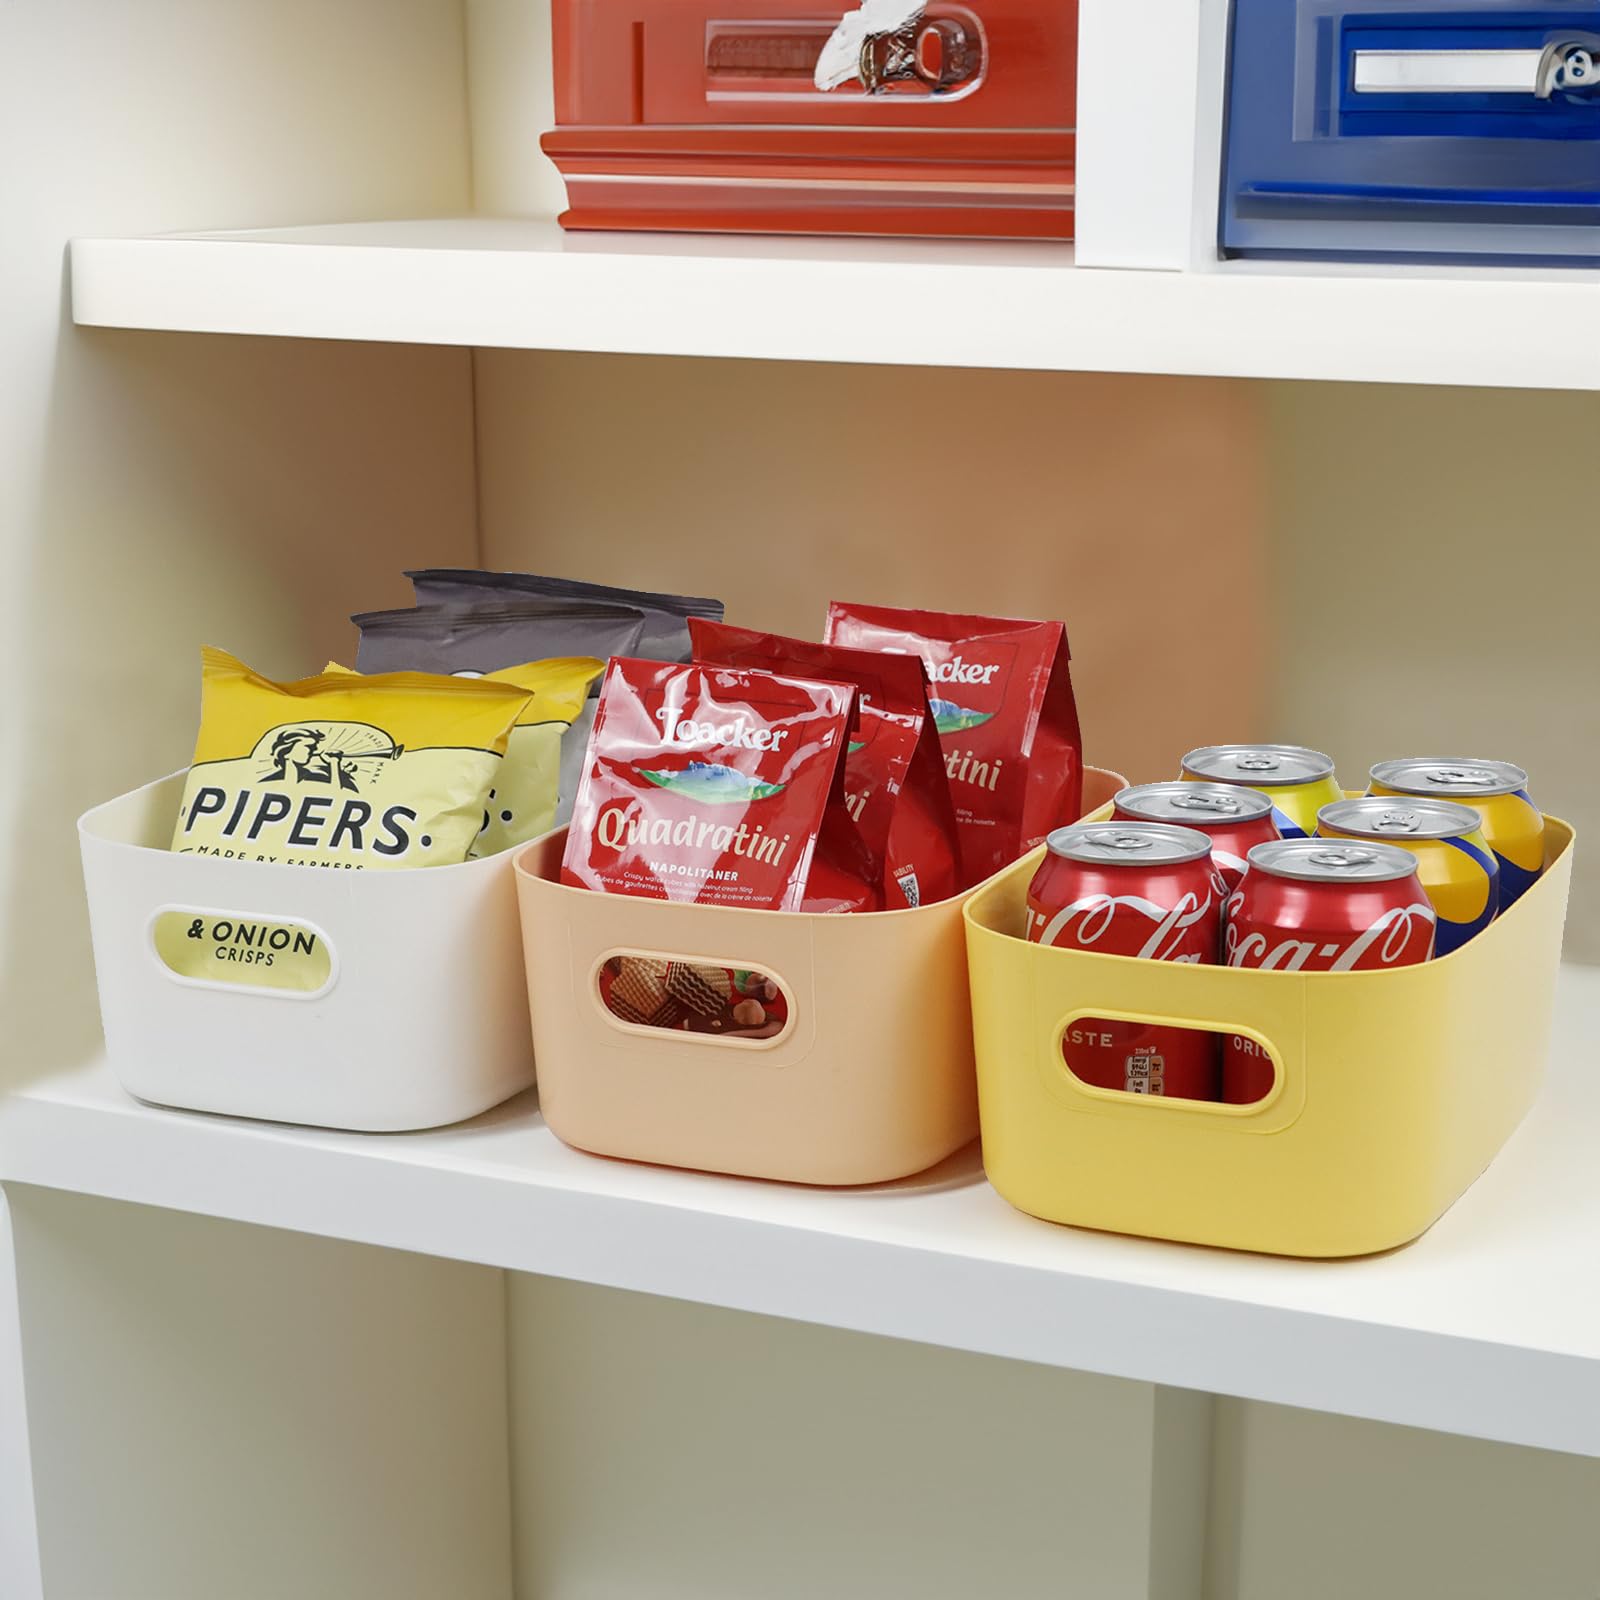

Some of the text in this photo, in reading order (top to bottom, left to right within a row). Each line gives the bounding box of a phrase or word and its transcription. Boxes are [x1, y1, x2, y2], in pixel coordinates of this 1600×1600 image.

[655, 706, 789, 752] Loacker
[184, 786, 417, 856] PIPERS
[597, 806, 791, 867] Quadratini
[197, 845, 248, 861] MADE
[615, 877, 624, 885] de
[623, 871, 644, 882] Crispy
[649, 861, 739, 882] NAPOLITANER
[187, 918, 316, 955] & ONION
[215, 946, 275, 966] CRISPS
